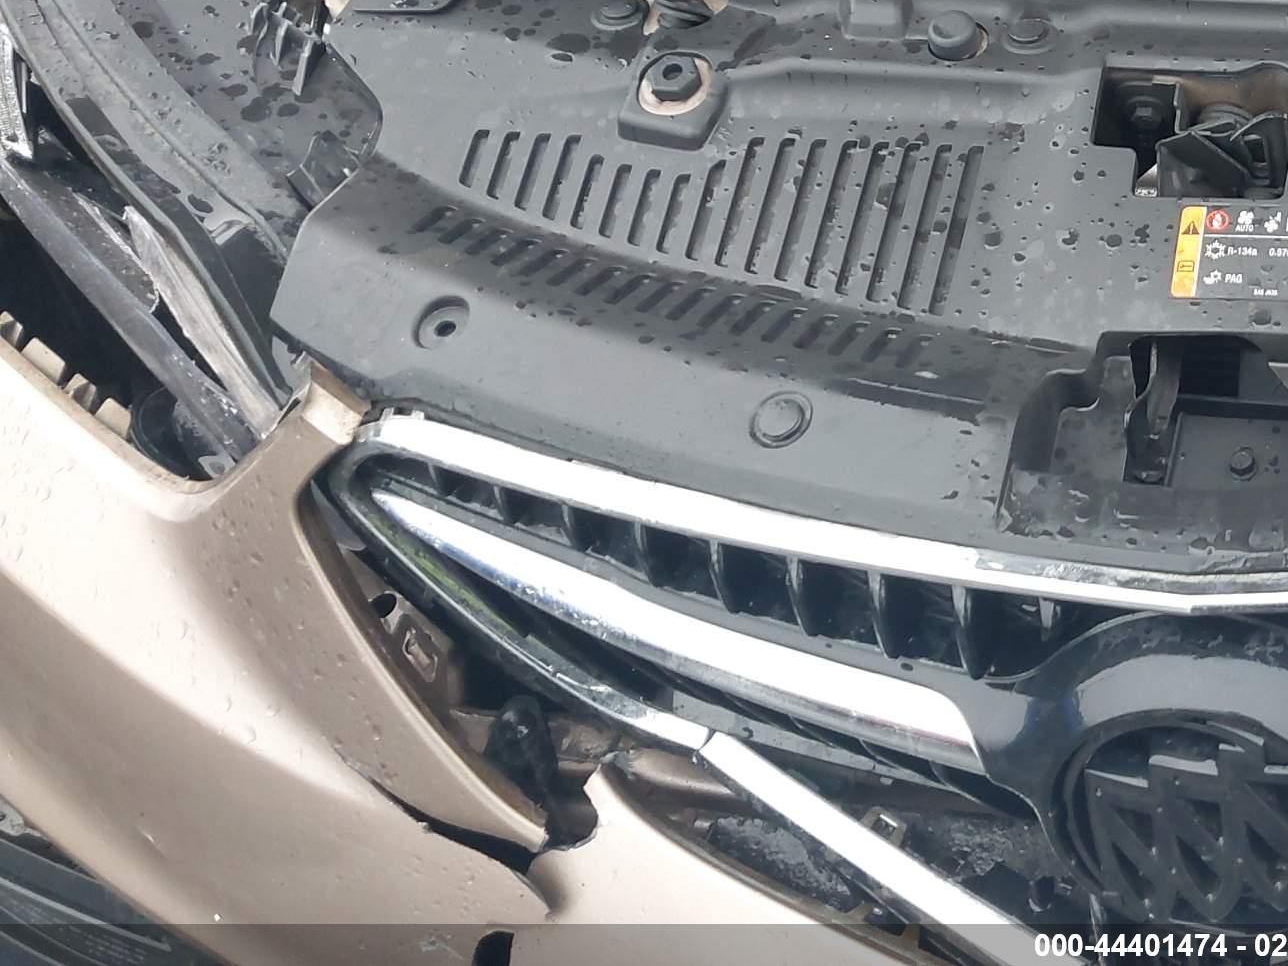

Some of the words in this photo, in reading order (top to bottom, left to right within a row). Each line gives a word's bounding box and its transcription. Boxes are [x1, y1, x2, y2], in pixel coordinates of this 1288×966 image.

[1235, 224, 1255, 233] AUTO
[1227, 246, 1258, 257] R-134a
[1225, 273, 1243, 284] PAG
